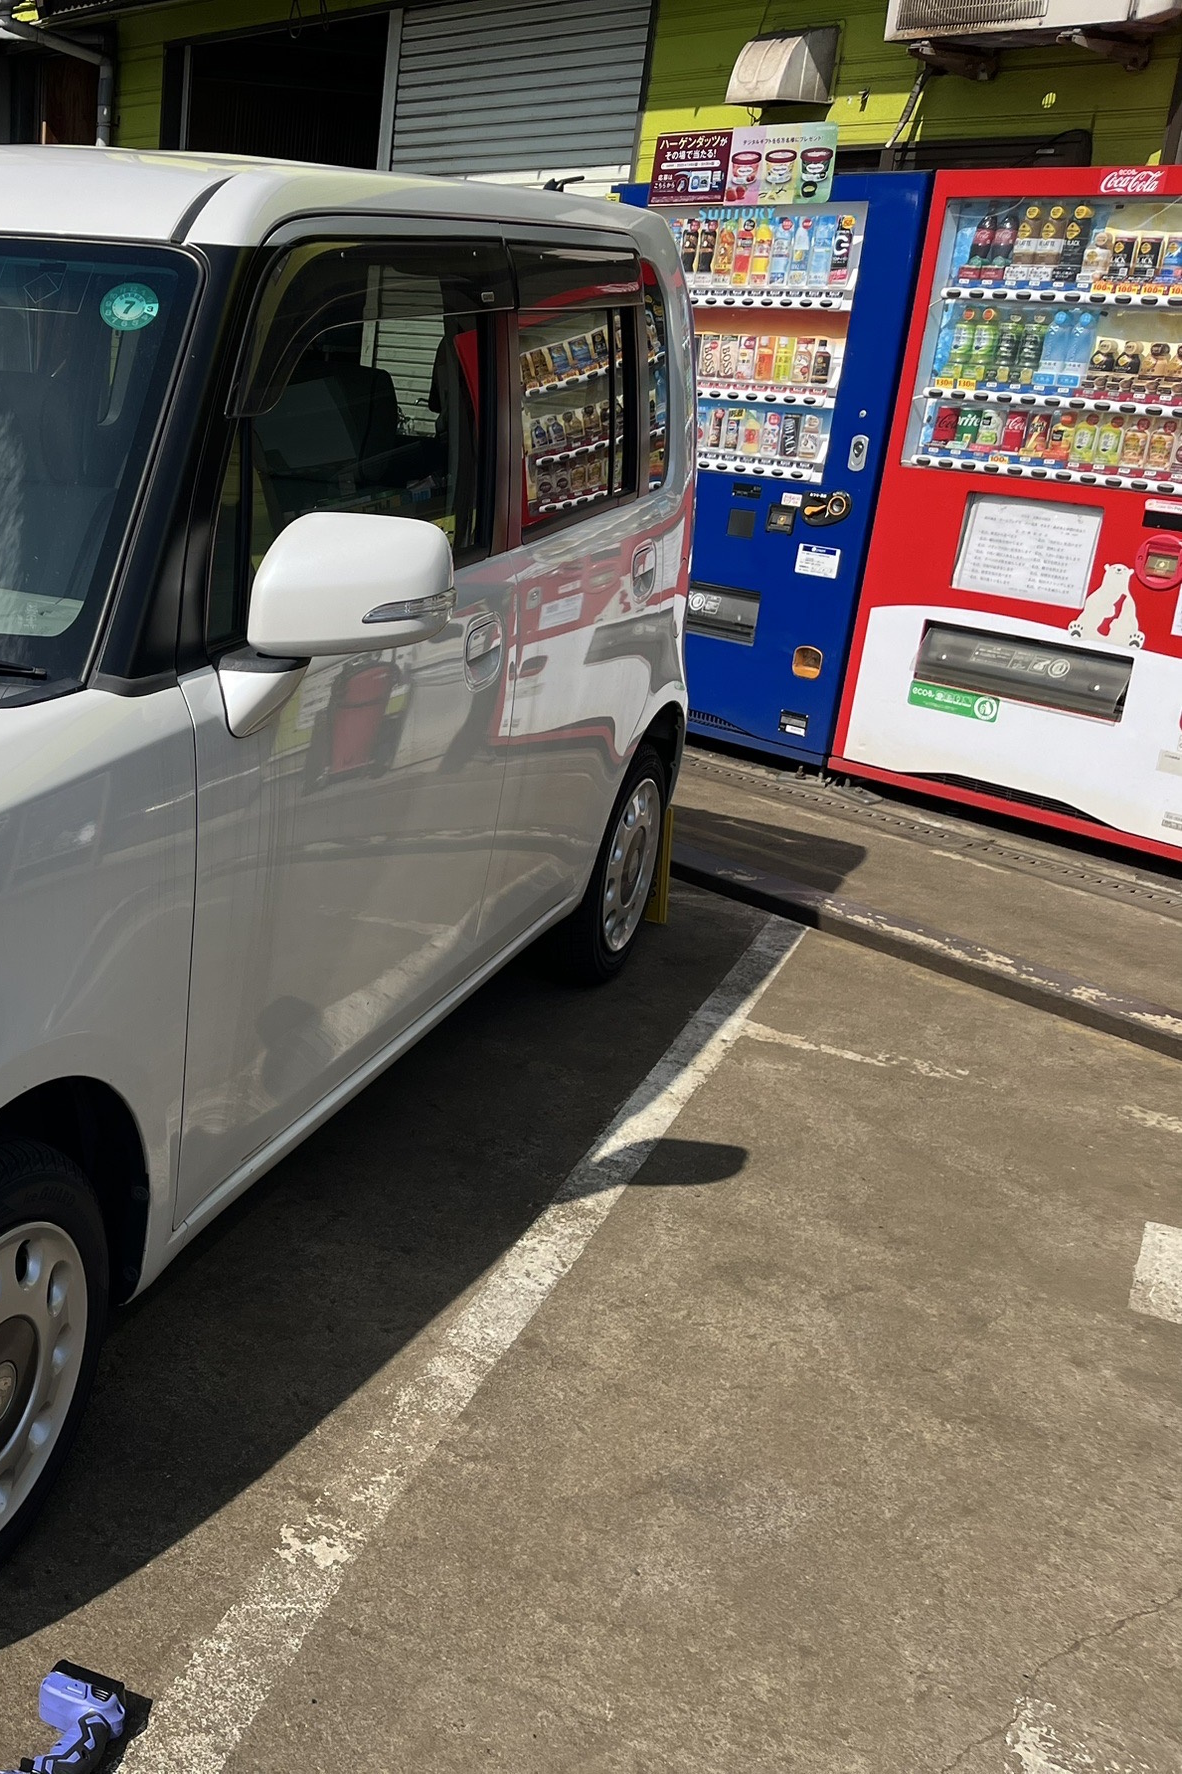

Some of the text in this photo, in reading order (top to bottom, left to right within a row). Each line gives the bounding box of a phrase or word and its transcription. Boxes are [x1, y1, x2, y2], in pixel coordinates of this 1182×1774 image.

[659, 136, 728, 149] ハーゲンダッツが
[665, 149, 717, 160] その場で当たる!
[1100, 171, 1165, 193] Coca-Cola
[123, 300, 136, 315] 7
[705, 347, 715, 374] BOSS
[723, 346, 732, 375] BOSS
[958, 413, 980, 427] rite
